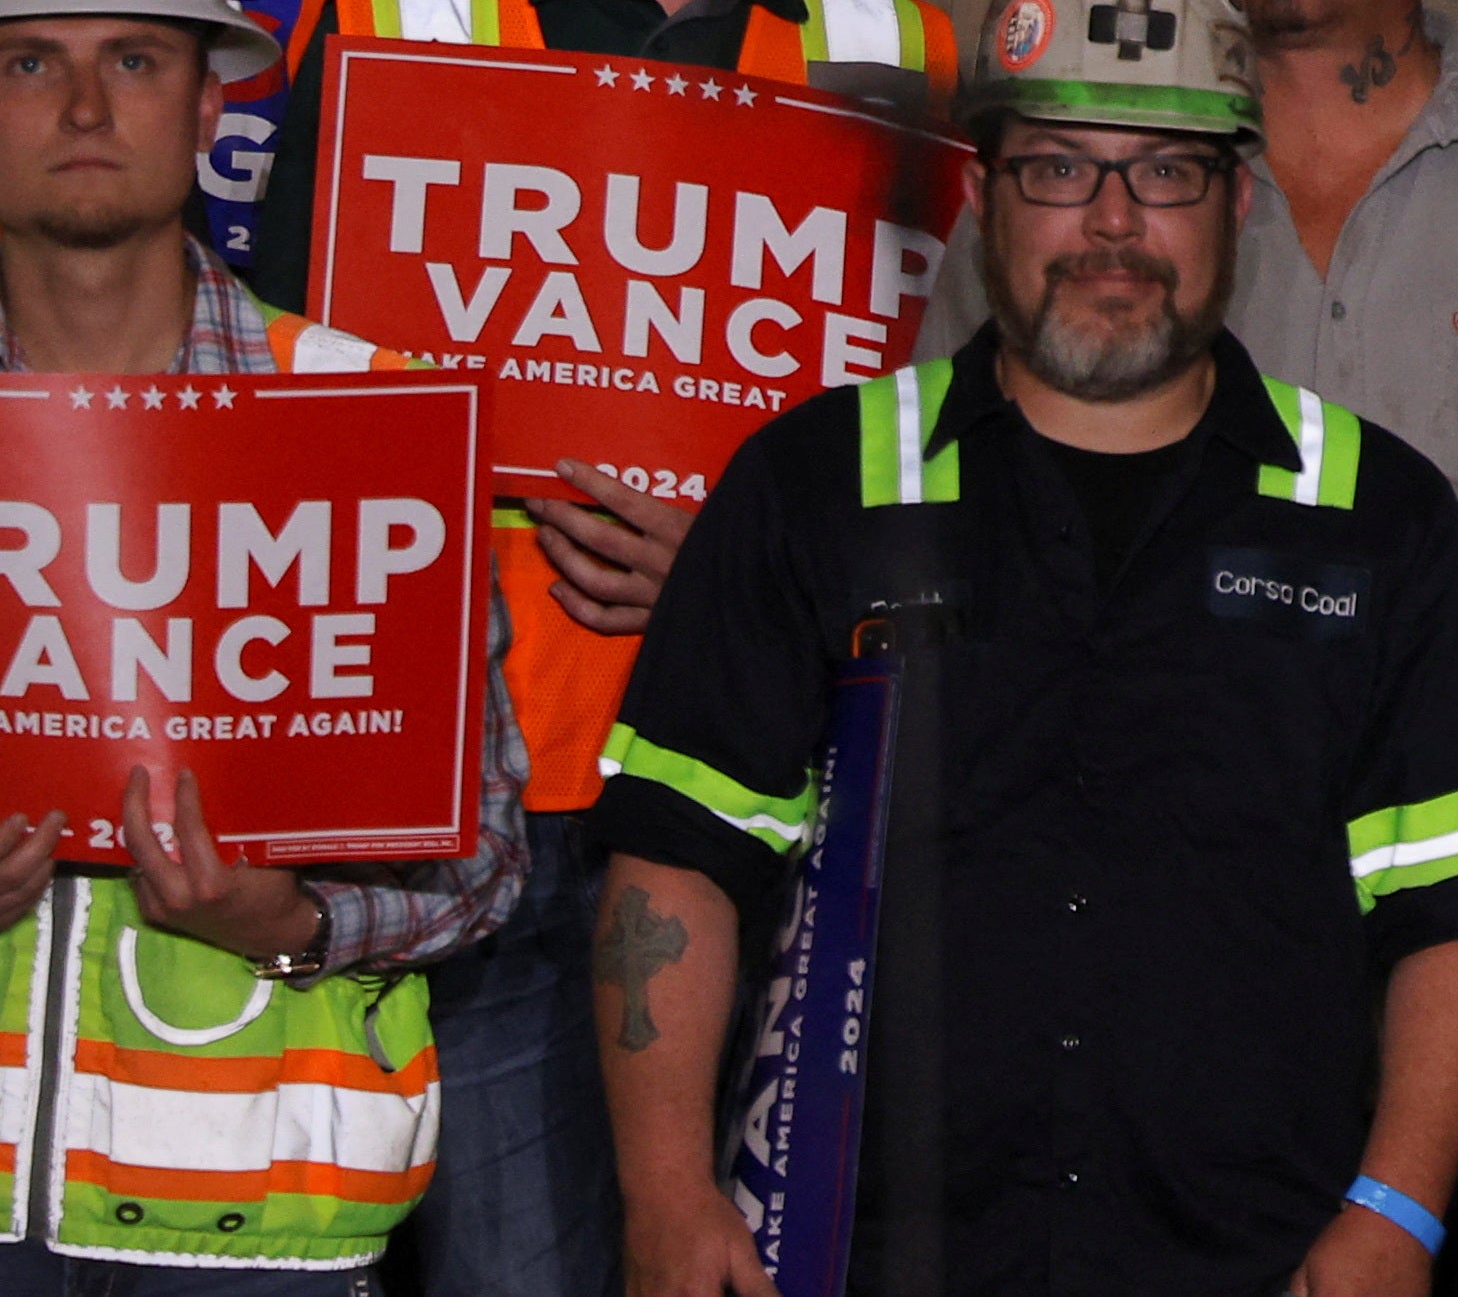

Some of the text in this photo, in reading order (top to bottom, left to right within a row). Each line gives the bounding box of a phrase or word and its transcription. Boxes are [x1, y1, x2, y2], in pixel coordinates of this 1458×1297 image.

[361, 155, 948, 320] TRUMP
[425, 262, 890, 389] VANCE
[500, 359, 788, 414] AMERICA GREAT
[1215, 570, 1357, 617] Corsa Coal
[0, 709, 404, 741] AMERICA GREAT AGAIN!
[772, 1013, 805, 1179] AMERICA
[791, 884, 819, 1002] GREAT
[810, 745, 839, 871] AGAIN!
[838, 956, 868, 1076] 2024
